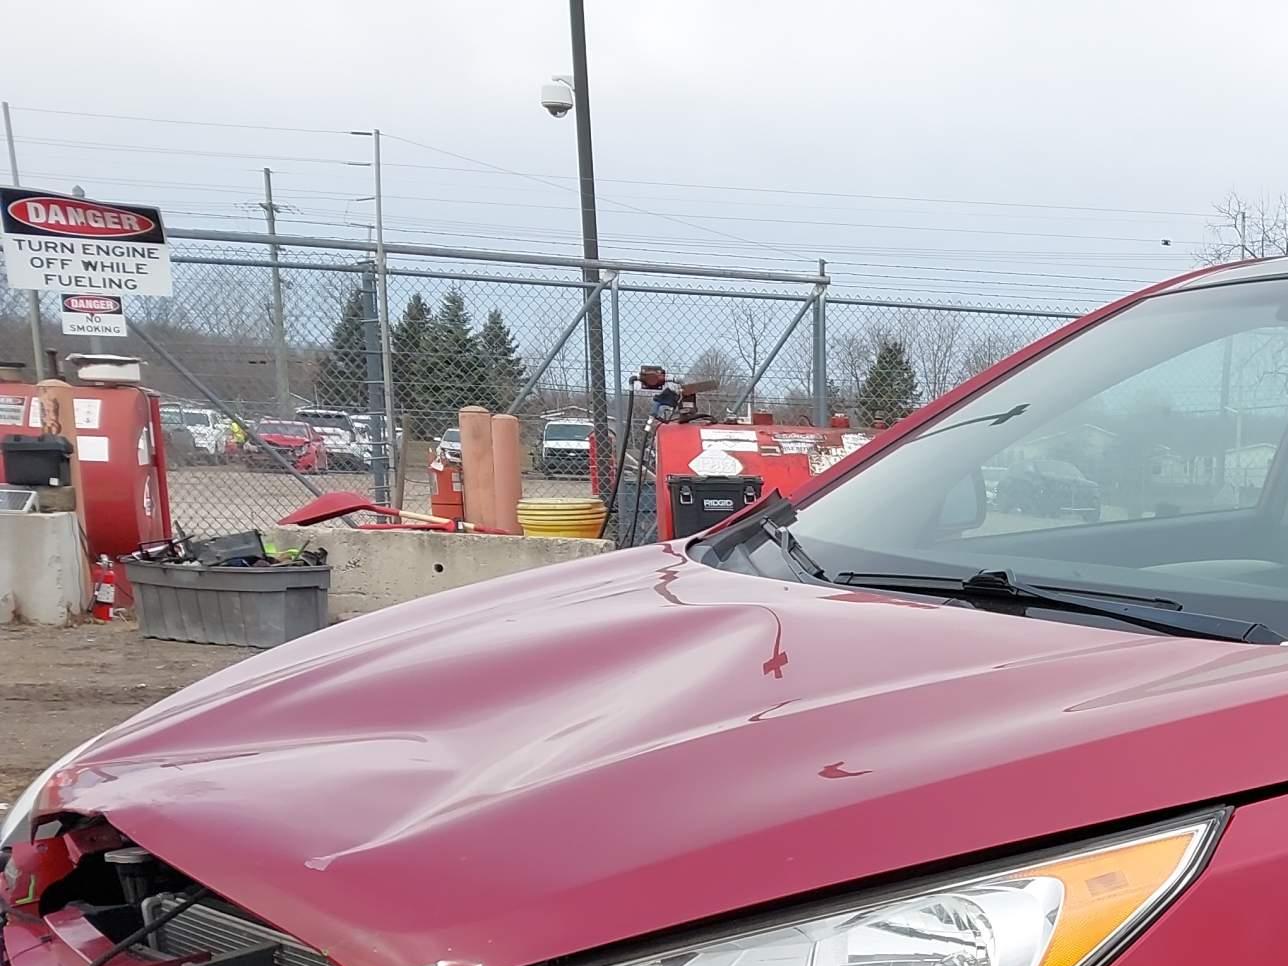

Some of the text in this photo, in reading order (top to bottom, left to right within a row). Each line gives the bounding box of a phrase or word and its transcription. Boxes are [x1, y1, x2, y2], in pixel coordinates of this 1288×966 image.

[26, 202, 141, 231] DANGER
[12, 239, 160, 259] TURN ENGINE
[30, 256, 149, 275] OFF WHILE
[44, 274, 138, 290] FUELING
[70, 298, 114, 309] DANGER
[86, 316, 101, 324] NO
[69, 324, 121, 334] SMOKING
[703, 499, 734, 507] RIDGID
